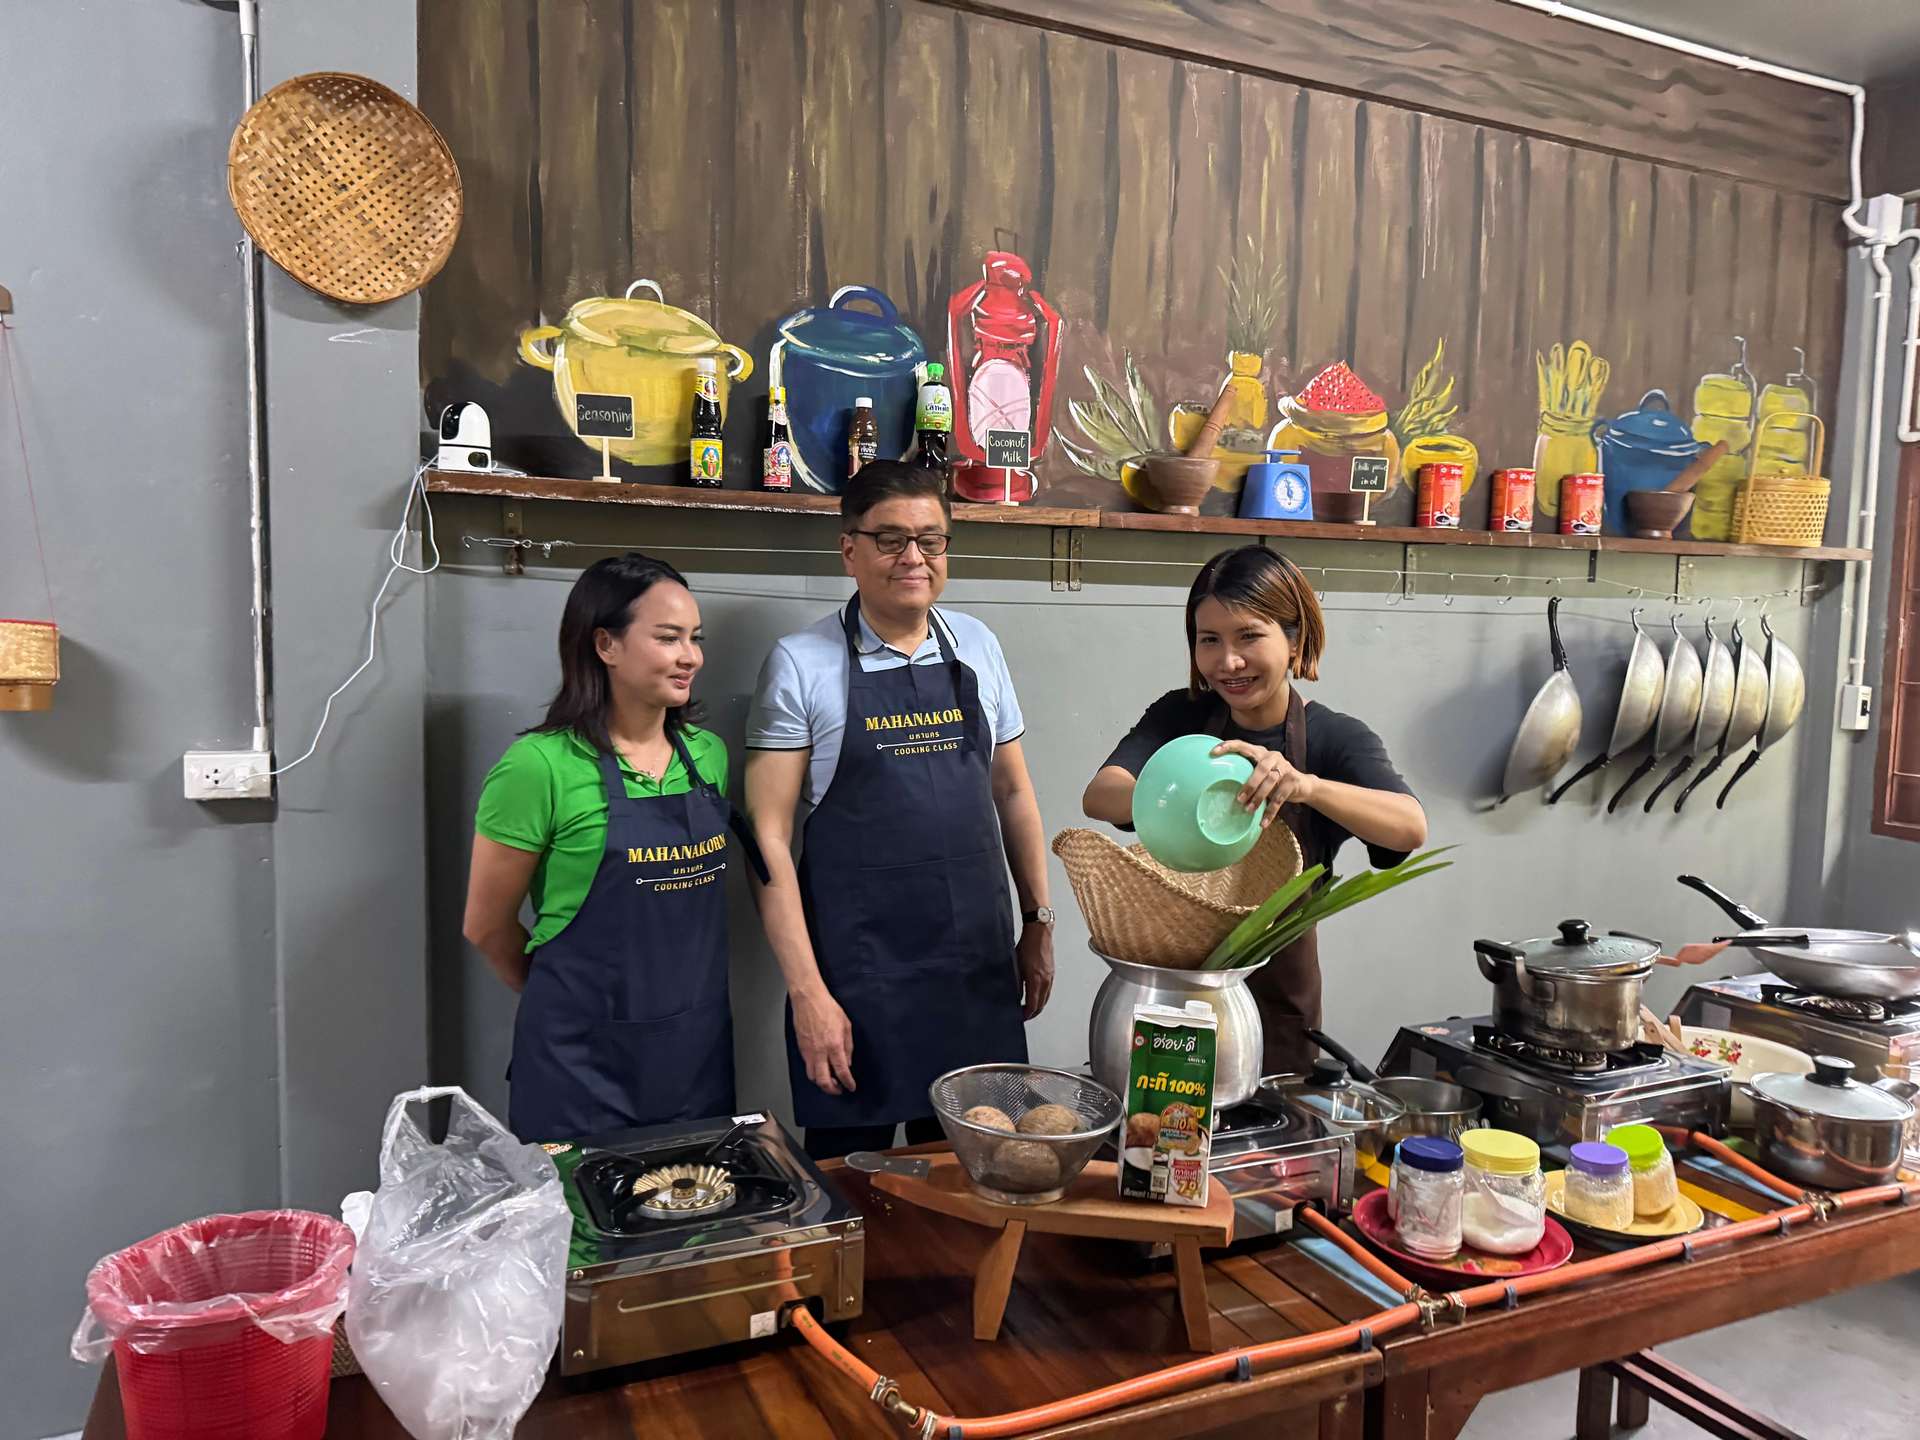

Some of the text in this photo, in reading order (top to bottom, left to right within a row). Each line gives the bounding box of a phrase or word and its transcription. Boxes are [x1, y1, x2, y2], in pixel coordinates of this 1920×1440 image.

[989, 435, 1026, 448] Coconut
[1001, 450, 1022, 463] Milk
[894, 742, 958, 755] COOKING CLASS
[627, 833, 727, 863] MAHANAKORN
[654, 873, 716, 892] COOKING CLASS
[1153, 1033, 1197, 1052] อร่อย-ดี
[1169, 1079, 1206, 1097] 100%
